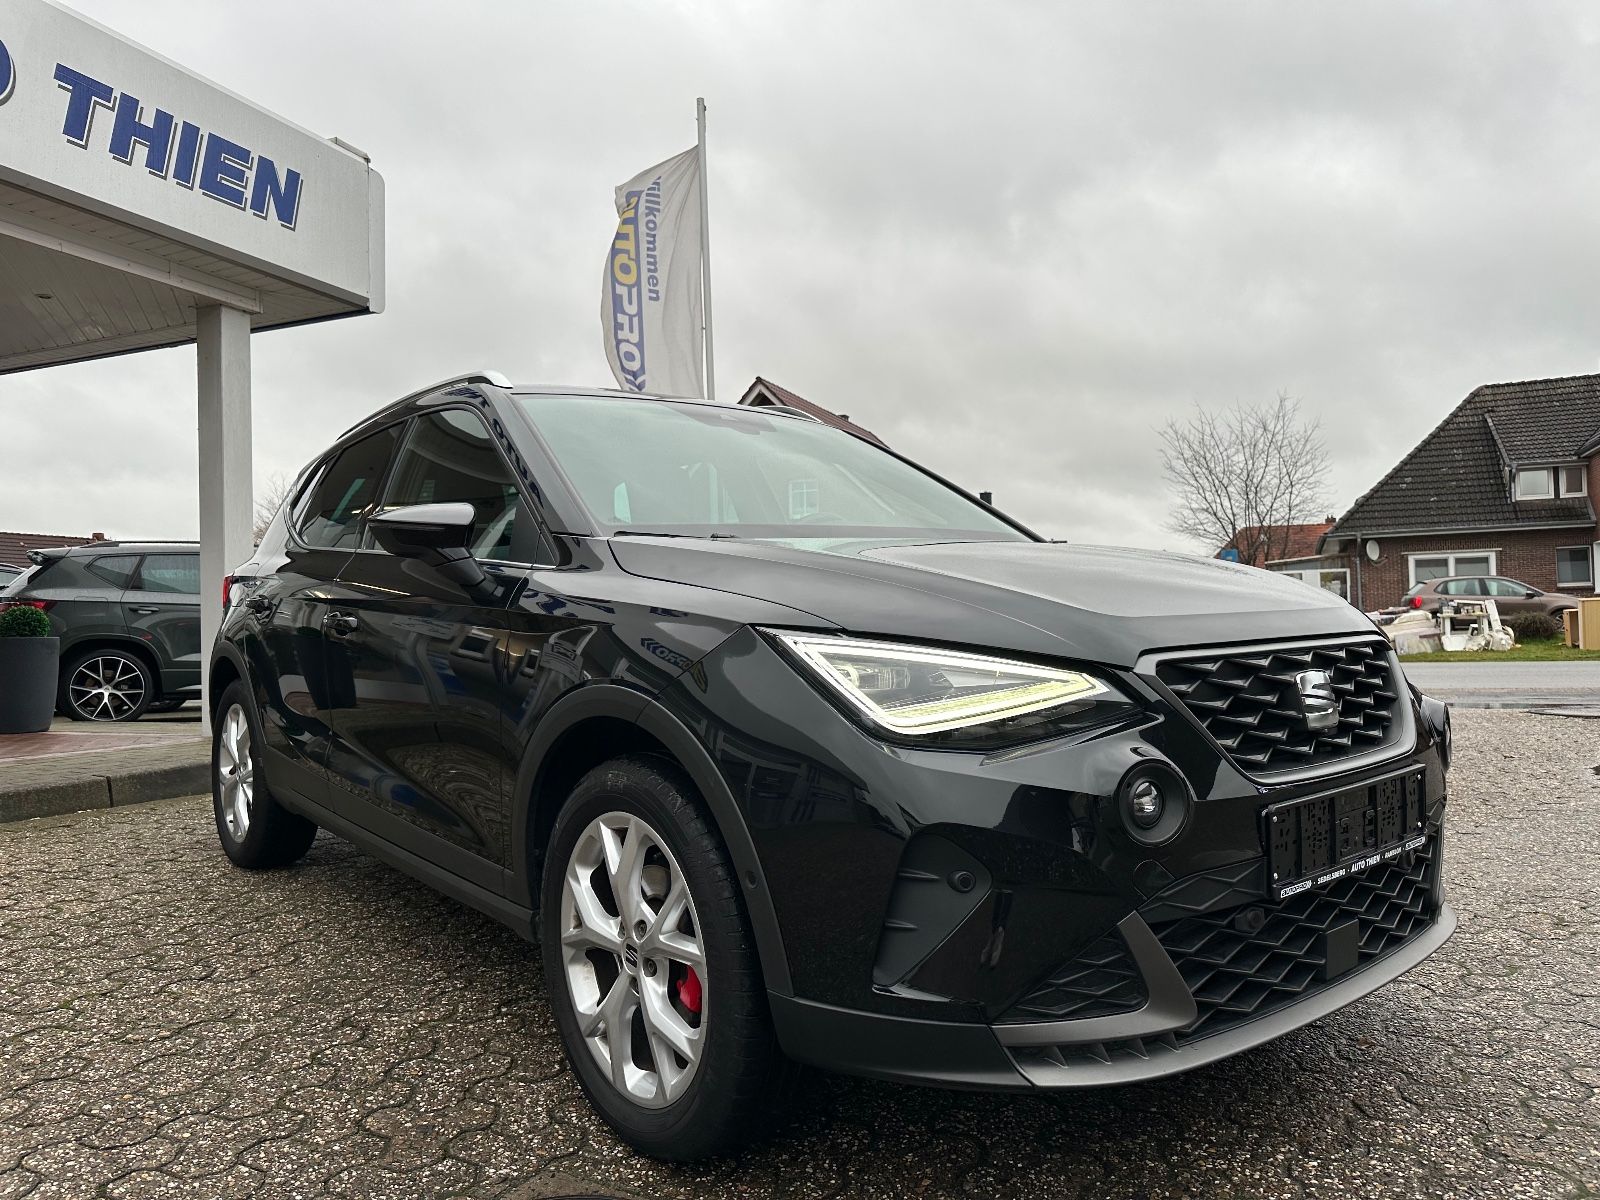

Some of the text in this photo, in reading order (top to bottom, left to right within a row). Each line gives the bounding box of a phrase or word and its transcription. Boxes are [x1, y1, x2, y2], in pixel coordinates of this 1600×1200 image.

[54, 62, 303, 232] THIEN
[1350, 860, 1366, 873] AUTO
[1366, 854, 1381, 867] THIEN
